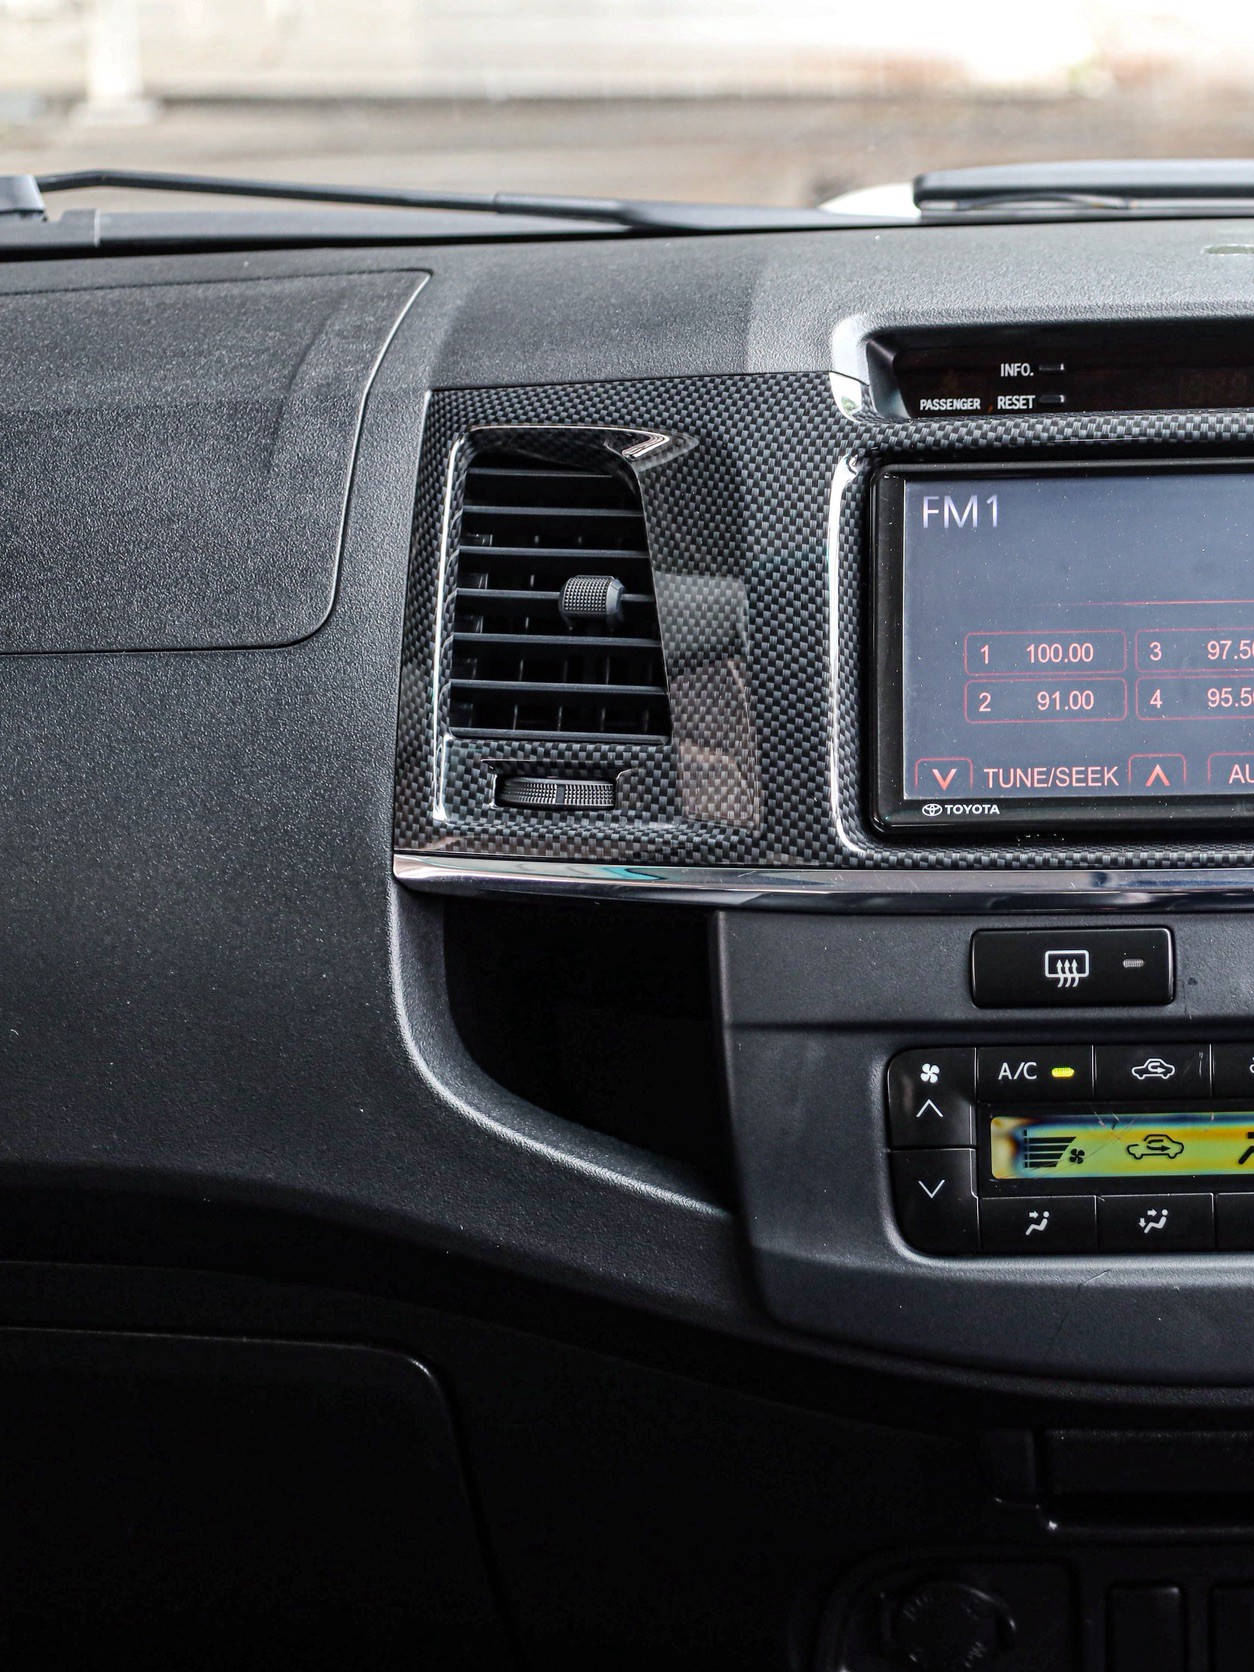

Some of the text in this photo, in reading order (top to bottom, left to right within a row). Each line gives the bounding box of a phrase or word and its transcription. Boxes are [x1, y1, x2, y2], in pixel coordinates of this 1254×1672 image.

[1000, 363, 1034, 377] INFO.
[920, 398, 981, 411] PASSENGER
[997, 395, 1036, 410] RESET
[922, 495, 999, 529] FM1
[978, 642, 1094, 663] 1 100.00
[1149, 641, 1163, 662] 3
[978, 689, 1095, 712] 2 91.00
[1149, 688, 1164, 709] 4
[983, 765, 1120, 788] TUNE/SEEK
[945, 803, 1000, 815] TOYOTA
[997, 1061, 1038, 1082] A/C
